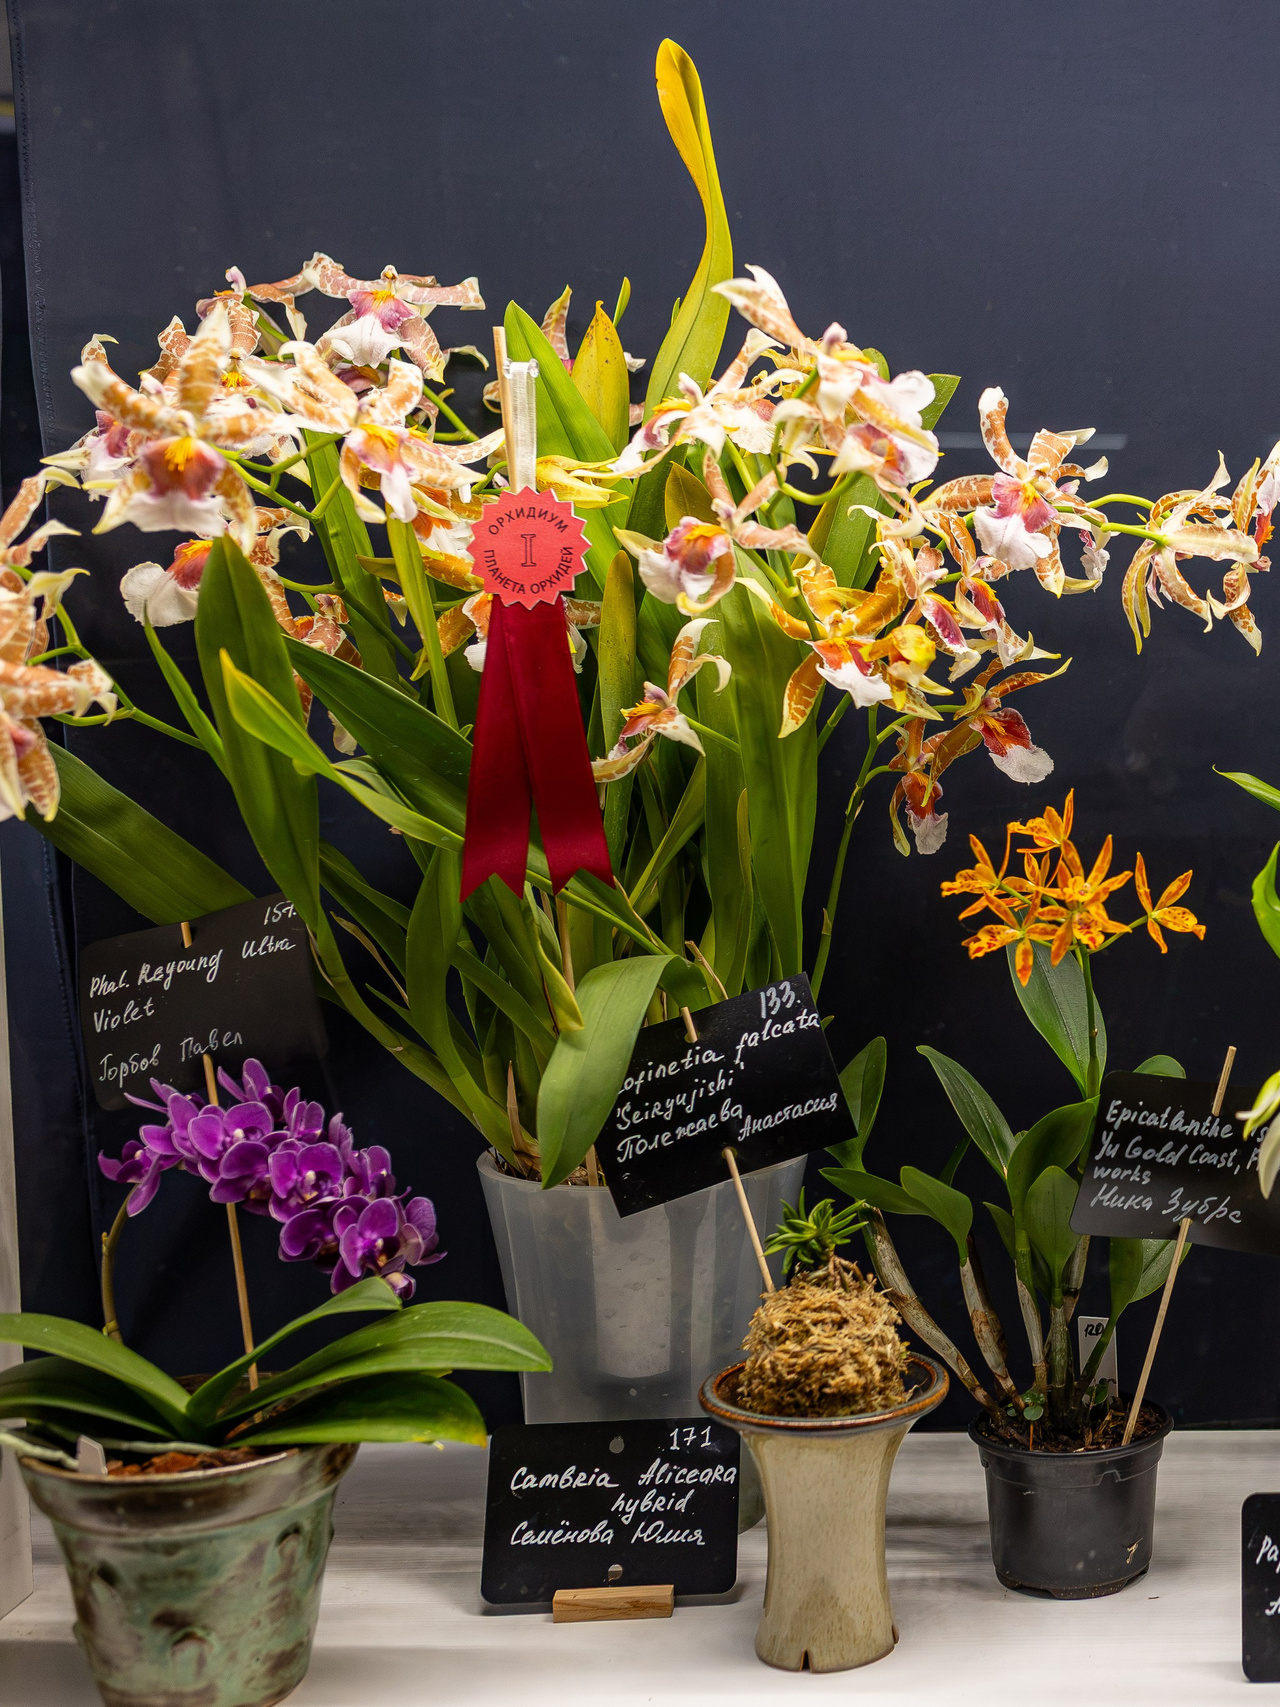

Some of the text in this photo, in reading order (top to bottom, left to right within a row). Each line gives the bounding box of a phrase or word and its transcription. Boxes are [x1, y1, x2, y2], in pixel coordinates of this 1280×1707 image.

[488, 507, 568, 535] ОРХИДИУМ
[483, 546, 574, 594] ПЛАНЕТА ОРХИДЕЙ
[90, 970, 130, 998] Phal.
[242, 936, 296, 959] Ultra
[93, 997, 155, 1033] Violet
[759, 980, 802, 1019] 133.
[180, 1028, 243, 1062] Павел
[734, 1008, 821, 1064] falcata
[617, 1092, 838, 1163] Полежаева Анастасия
[1095, 1131, 1118, 1160] Yu
[1125, 1136, 1189, 1166] Gold
[1188, 1144, 1240, 1175] Coast,
[1093, 1165, 1152, 1184] works
[1090, 1183, 1153, 1211] Ника
[670, 1426, 713, 1450] 171
[510, 1458, 737, 1490] Cambria Aliceara
[611, 1489, 695, 1525] hybrid
[510, 1520, 706, 1545] Семёнова Юлия
